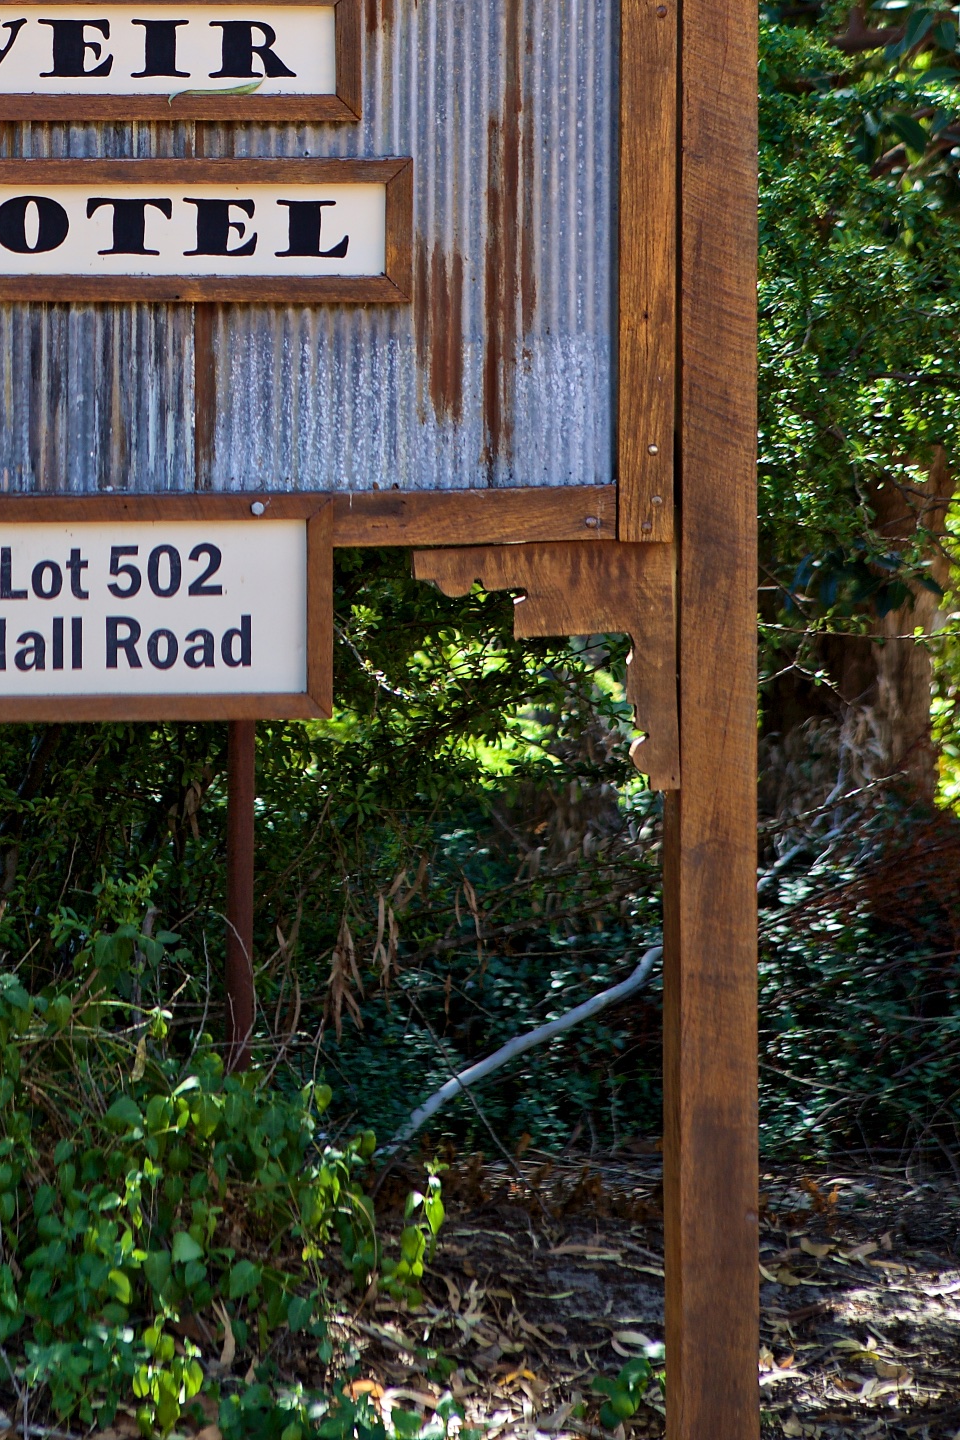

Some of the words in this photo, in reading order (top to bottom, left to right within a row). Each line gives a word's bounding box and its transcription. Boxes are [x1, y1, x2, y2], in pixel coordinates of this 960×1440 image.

[0, 546, 90, 600] Lot
[107, 542, 223, 599] 502
[106, 614, 252, 670] Road
